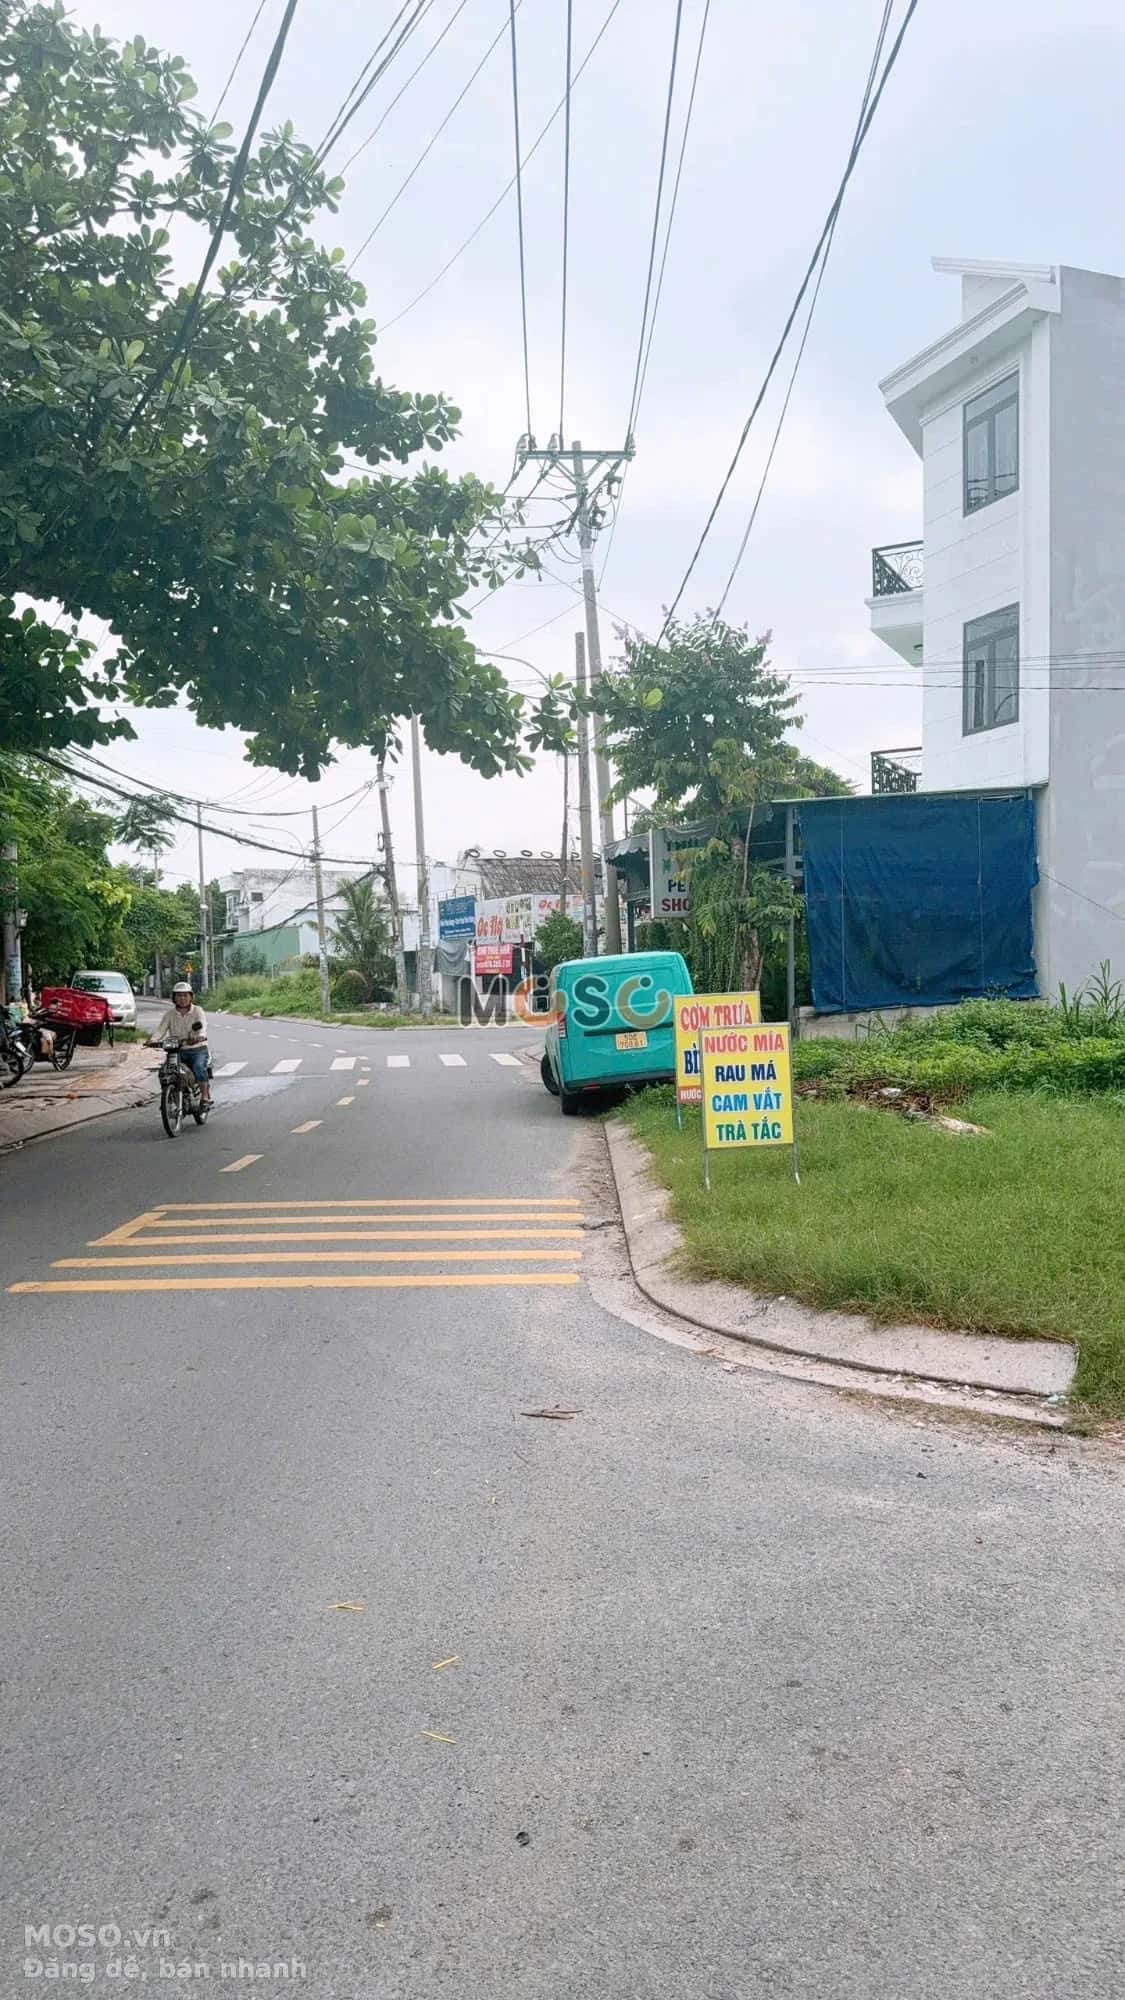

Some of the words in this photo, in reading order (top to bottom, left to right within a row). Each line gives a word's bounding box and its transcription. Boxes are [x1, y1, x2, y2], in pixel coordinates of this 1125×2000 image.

[680, 1002, 710, 1031] CƠM
[713, 1000, 753, 1026] TRƯA
[704, 1032, 748, 1053] NƯỚC
[753, 1030, 785, 1051] MÍA
[684, 1043, 701, 1074] BÌ
[715, 1065, 746, 1082] RAU
[751, 1060, 777, 1081] MÁ
[712, 1094, 748, 1112] CAM
[716, 1120, 747, 1141] TRÀ
[751, 1116, 782, 1140] TẮC
